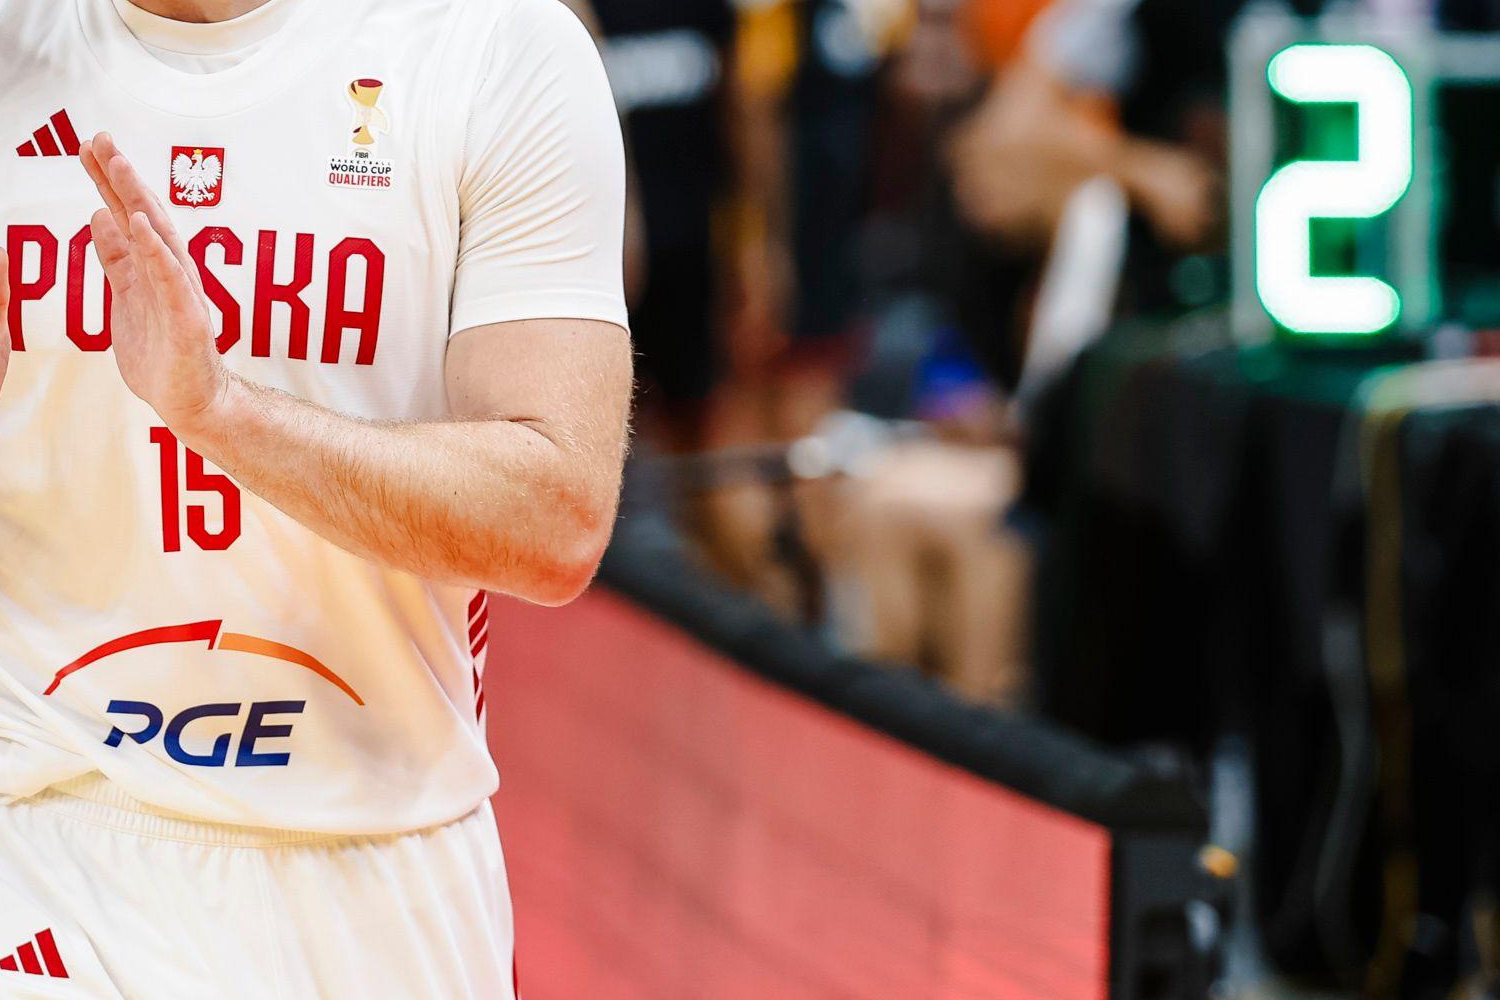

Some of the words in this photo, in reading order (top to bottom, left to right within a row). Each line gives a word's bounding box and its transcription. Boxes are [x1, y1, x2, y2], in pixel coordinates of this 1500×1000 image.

[329, 173, 391, 187] QUALIFIERS
[330, 163, 368, 173] WORLD
[1255, 44, 1413, 334] 2
[7, 224, 385, 366] POSKA
[150, 426, 241, 552] 15
[102, 700, 306, 768] PGE
